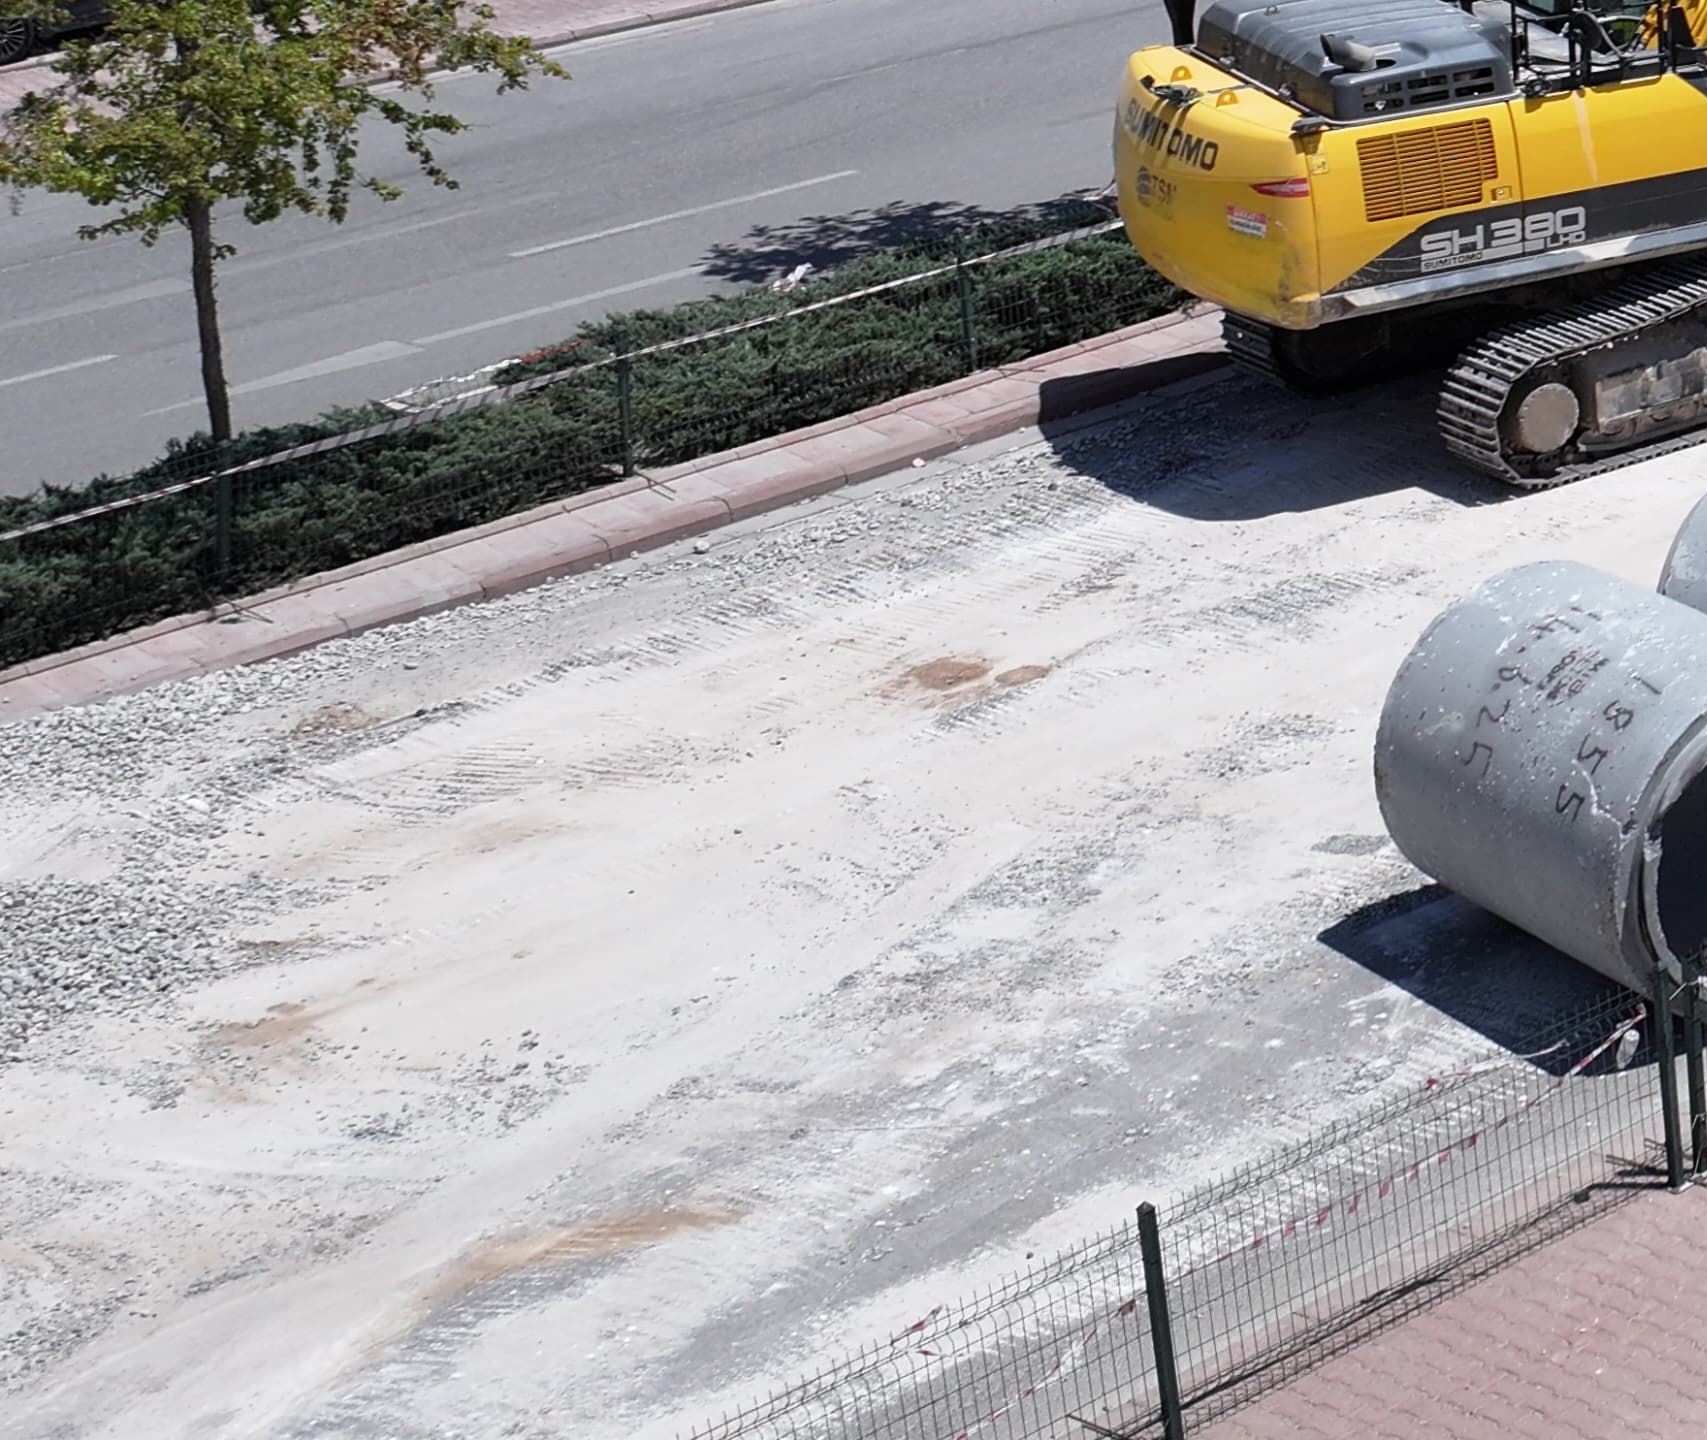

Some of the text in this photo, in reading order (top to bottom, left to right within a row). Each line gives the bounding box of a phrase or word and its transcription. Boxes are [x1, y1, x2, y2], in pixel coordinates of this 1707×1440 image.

[1125, 97, 1219, 172] SUMITOMO
[1423, 251, 1483, 270] SUMITOMO
[1555, 668, 1663, 823] 1855
